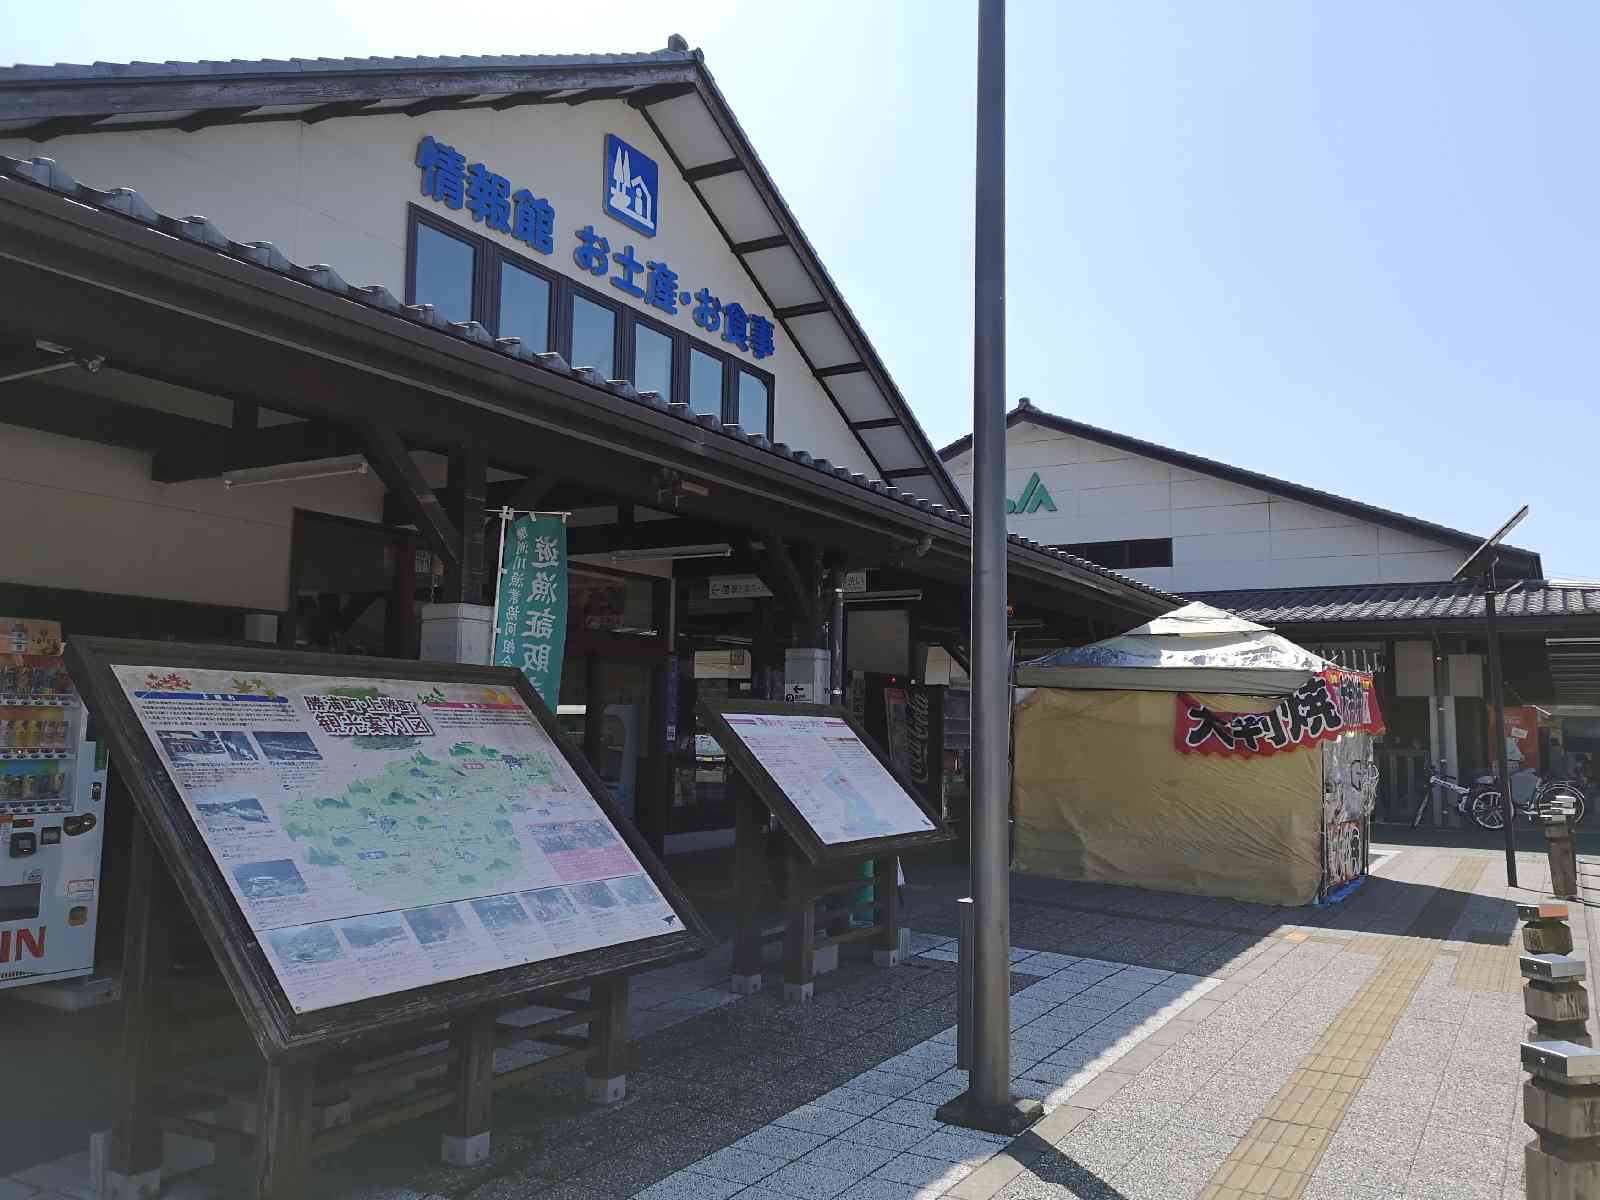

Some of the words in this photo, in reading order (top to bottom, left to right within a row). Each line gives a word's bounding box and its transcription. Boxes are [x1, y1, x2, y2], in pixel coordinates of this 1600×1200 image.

[415, 134, 554, 255] 情報館
[572, 225, 775, 360] お土産・お食事
[314, 711, 436, 736] 観光案内図
[1186, 676, 1343, 751] 大判焼
